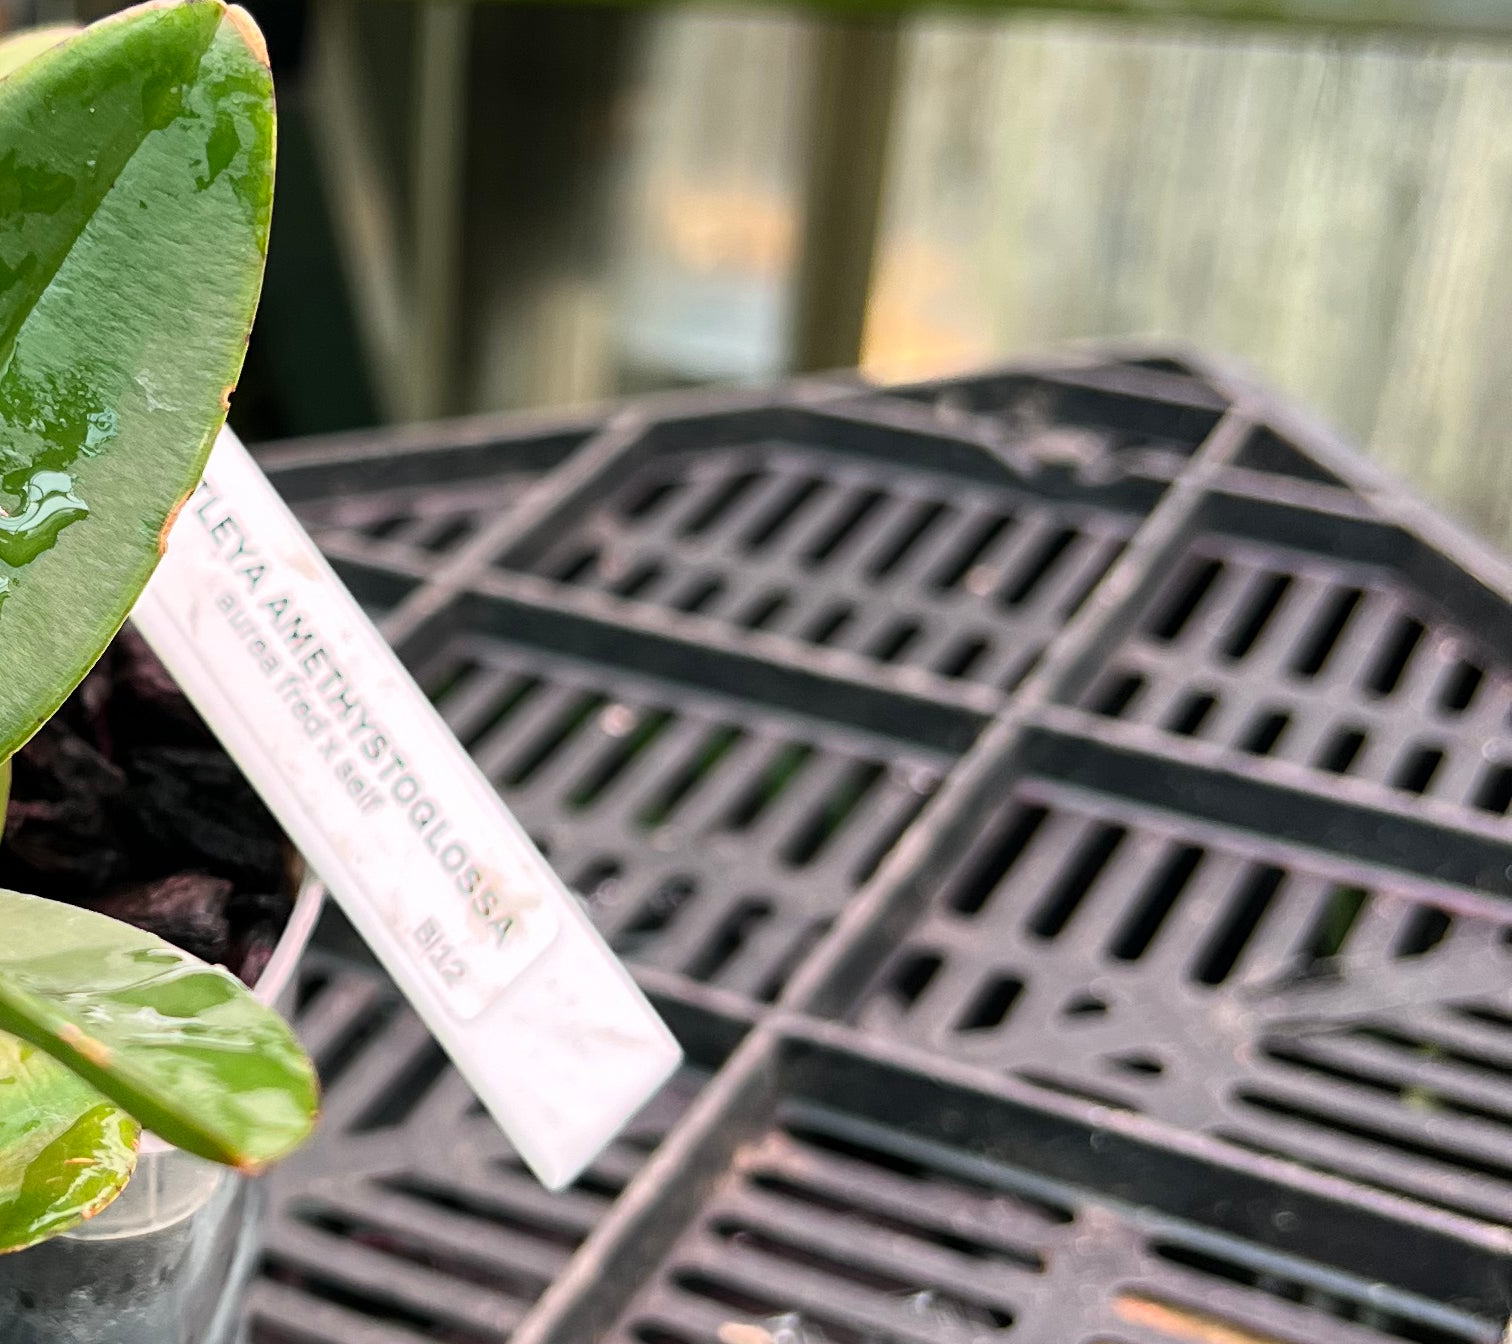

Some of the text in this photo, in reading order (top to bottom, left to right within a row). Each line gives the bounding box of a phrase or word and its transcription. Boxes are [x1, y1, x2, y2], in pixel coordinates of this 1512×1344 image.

[214, 593, 278, 676] aurea
[272, 673, 330, 739] fred
[332, 758, 388, 815] self
